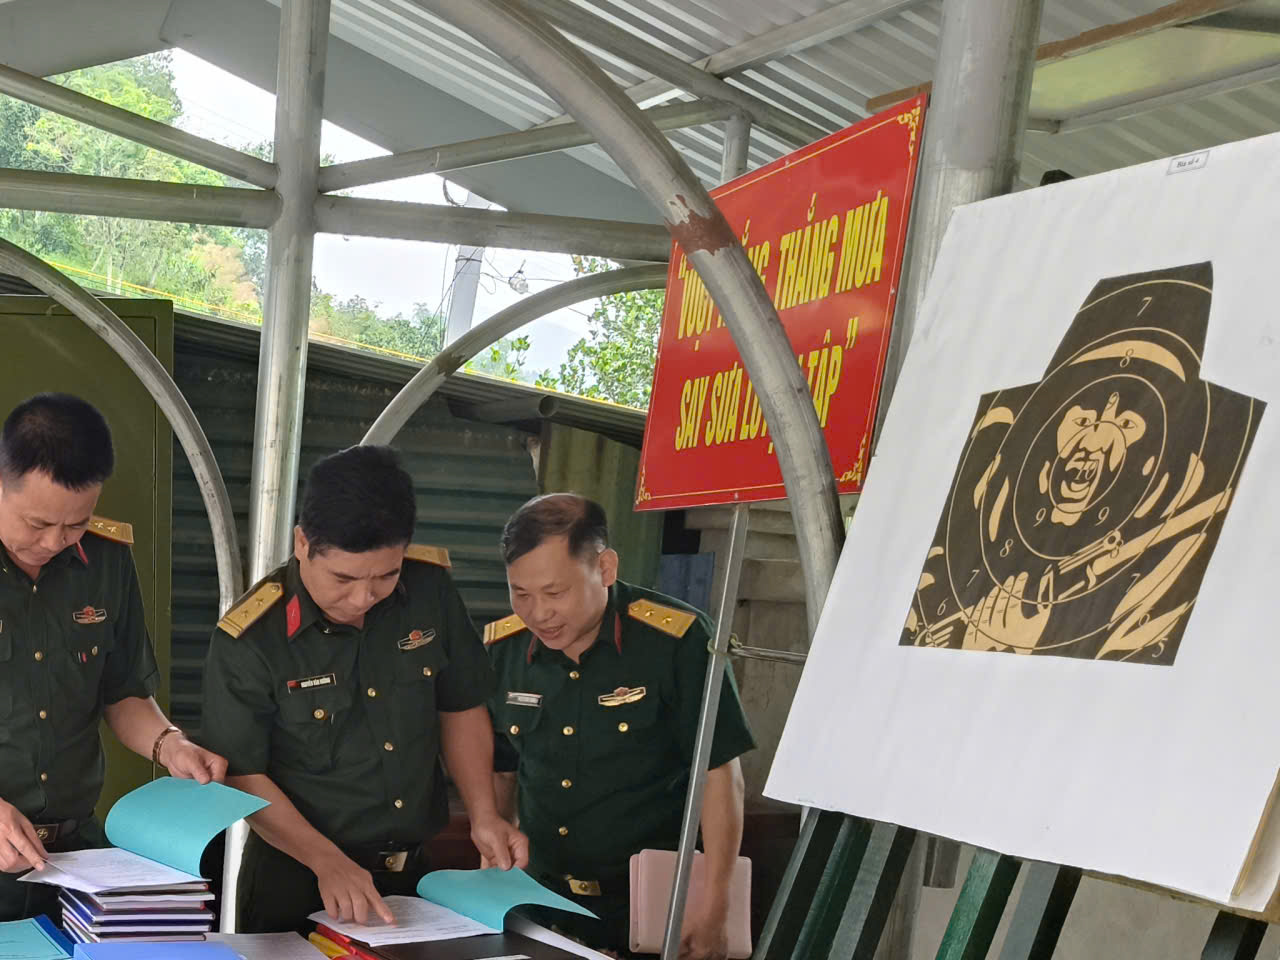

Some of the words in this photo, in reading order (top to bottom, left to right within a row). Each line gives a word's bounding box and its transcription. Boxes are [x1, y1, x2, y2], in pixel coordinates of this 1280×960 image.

[774, 191, 839, 311] THẮNG
[835, 189, 889, 294] MƯA
[1136, 296, 1153, 317] 7
[1119, 347, 1135, 369] 8
[675, 376, 710, 451] SAY
[704, 361, 744, 447] SƯA
[1032, 507, 1047, 528] 9
[1094, 506, 1110, 527] 9
[999, 538, 1014, 558] 8
[966, 569, 980, 588] 7
[1125, 572, 1141, 593] 7
[936, 598, 949, 616] 6
[1151, 637, 1169, 658] 5
